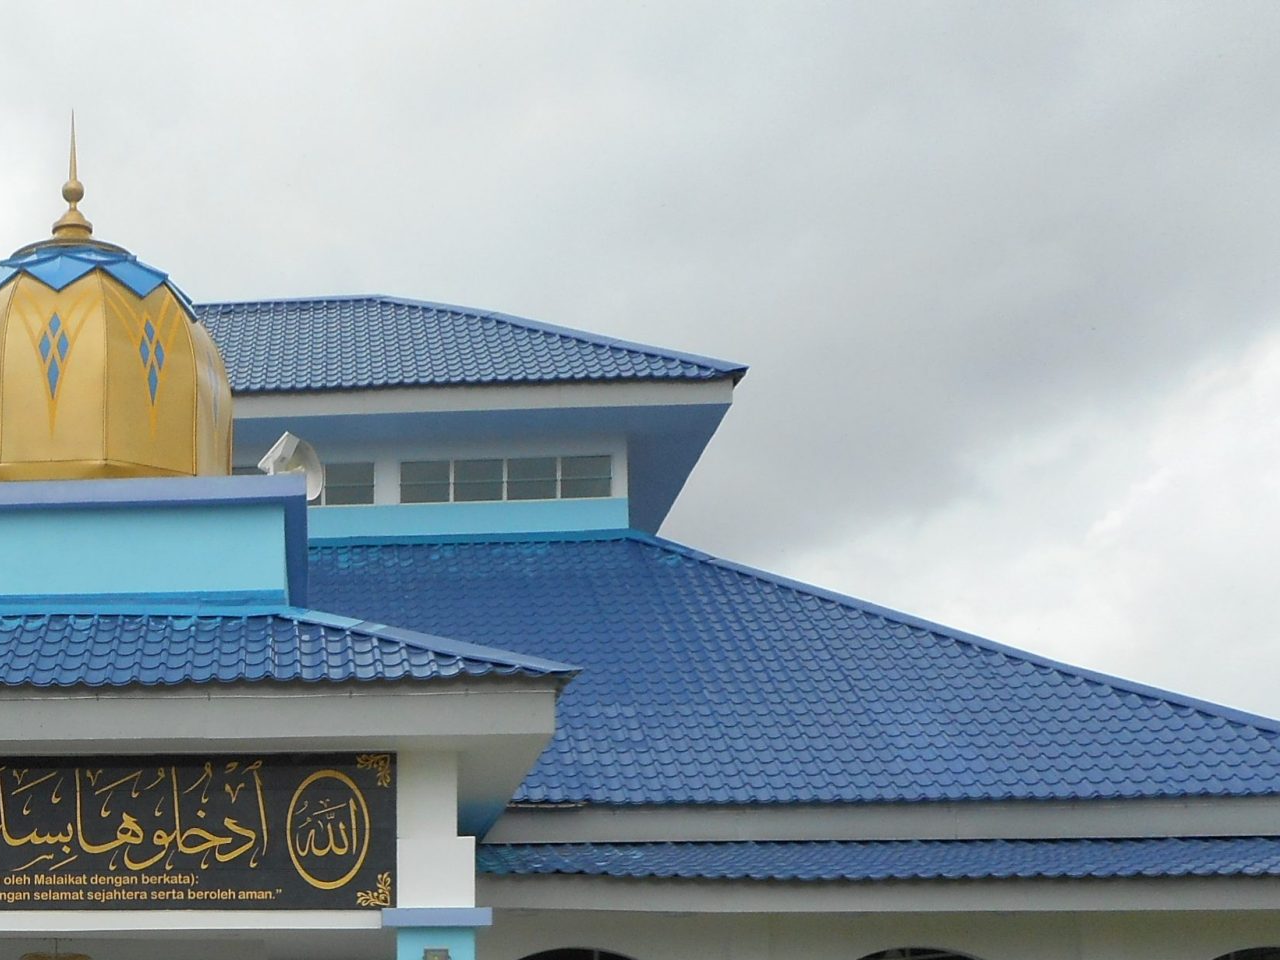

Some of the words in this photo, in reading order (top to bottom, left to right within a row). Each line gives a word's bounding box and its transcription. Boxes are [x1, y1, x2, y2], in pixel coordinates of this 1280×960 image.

[3, 874, 31, 886] oleh
[34, 874, 88, 886] Malaikat
[90, 873, 138, 888] dengan
[141, 873, 199, 887] berkata):
[34, 889, 84, 901] selamat
[87, 888, 148, 903] sejahtera
[151, 888, 185, 900] serta
[188, 888, 236, 900] beroleh
